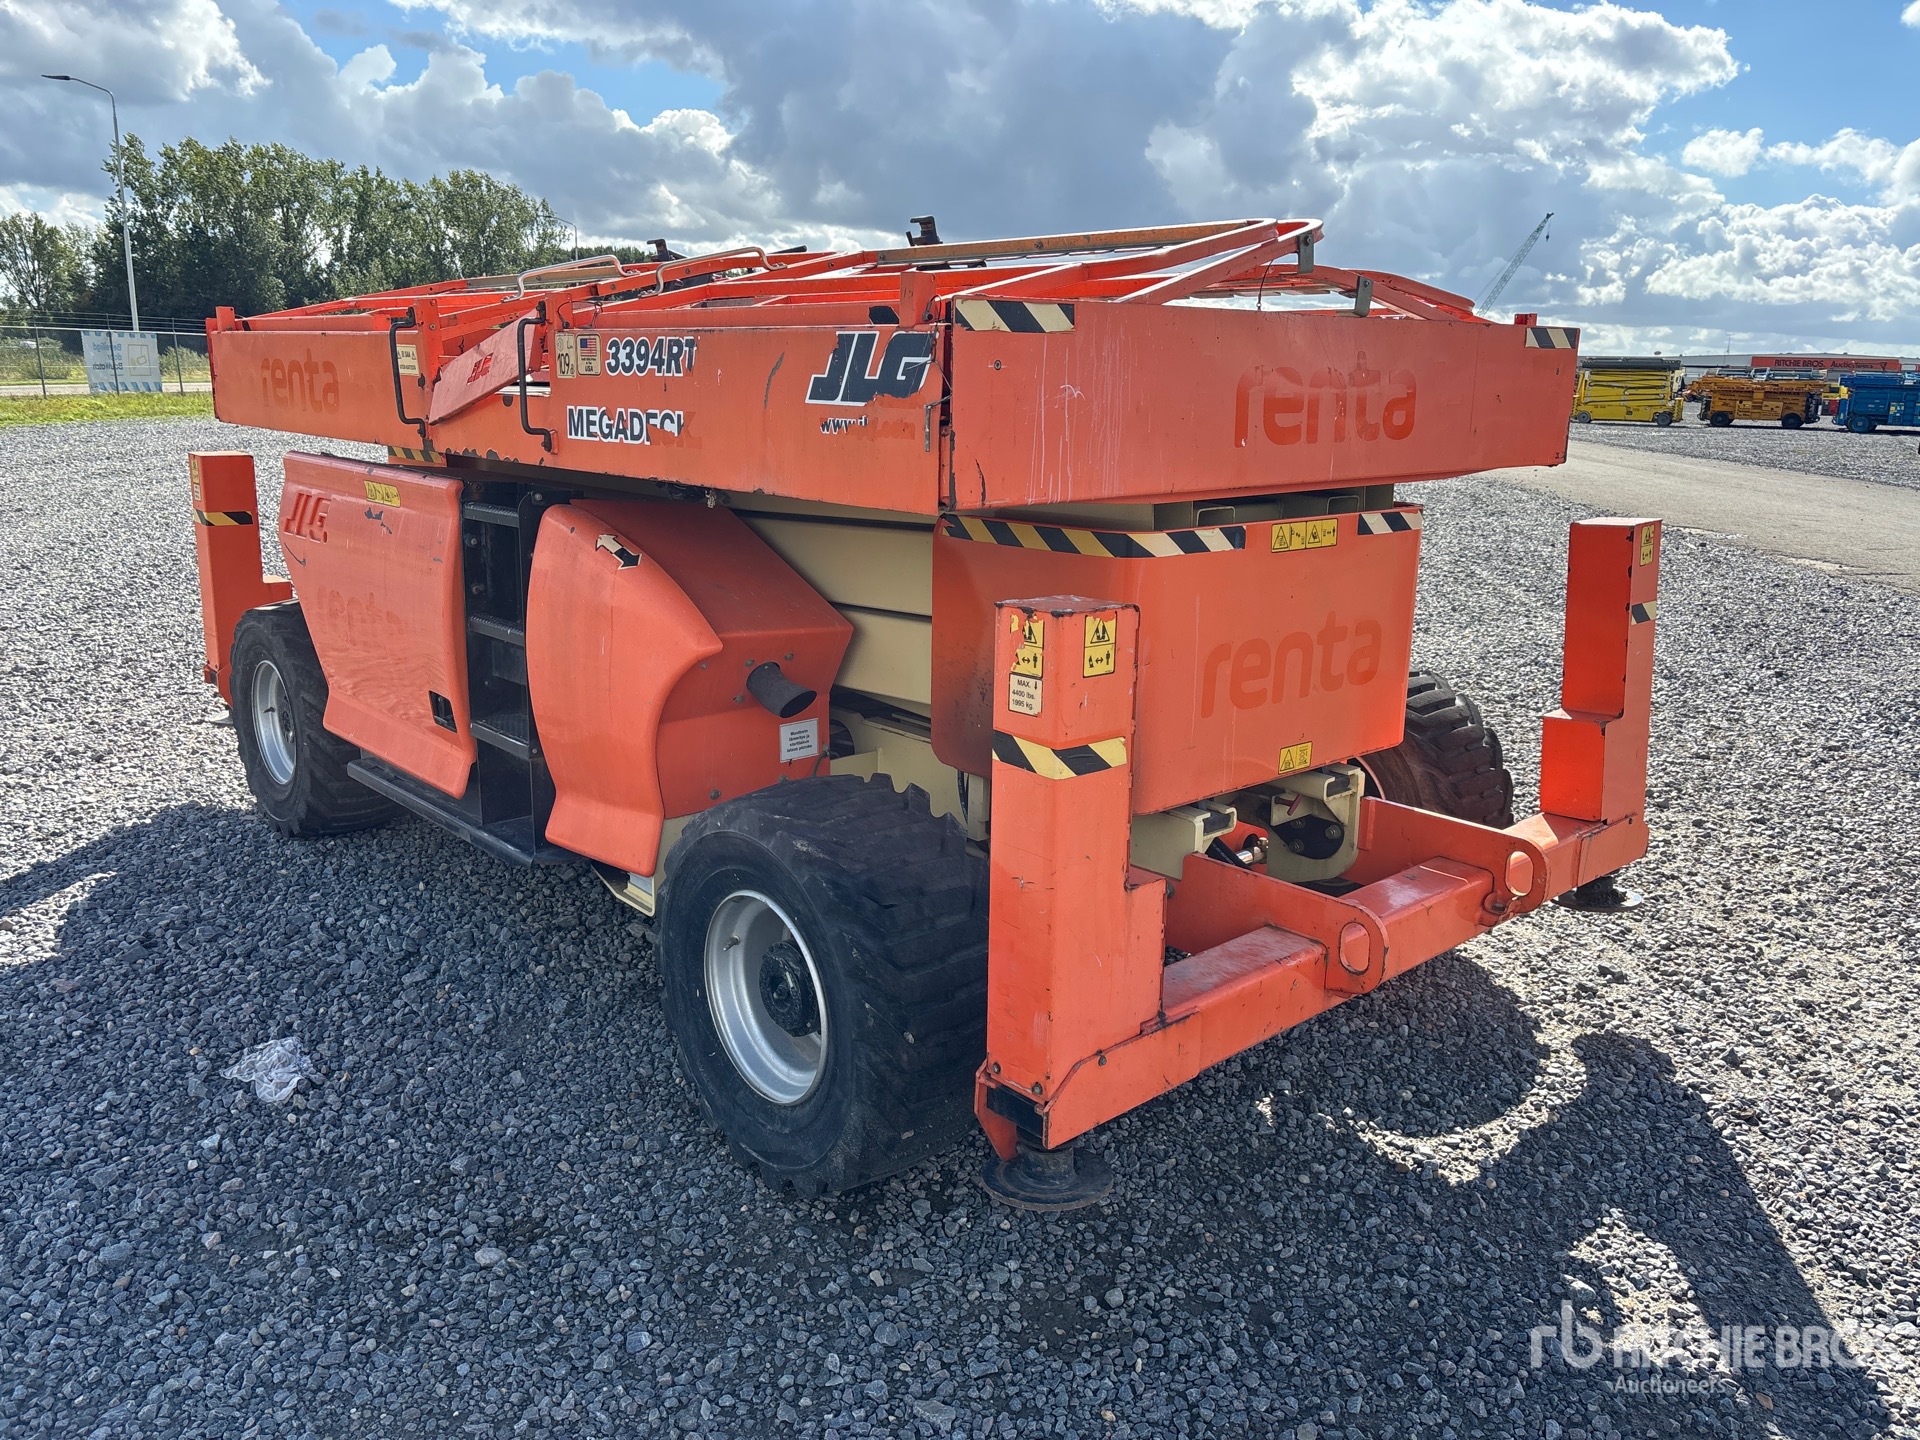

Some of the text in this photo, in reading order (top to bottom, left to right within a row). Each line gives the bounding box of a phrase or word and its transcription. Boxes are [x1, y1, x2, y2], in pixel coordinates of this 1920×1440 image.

[605, 336, 697, 376] 3394RT
[805, 331, 938, 406] JLG
[1774, 359, 1801, 367] RITCHIE
[1802, 359, 1826, 368] BROS.
[261, 348, 340, 415] renta
[1234, 351, 1416, 448] renta
[284, 491, 331, 543] JLG
[1017, 679, 1031, 688] MAX.
[1200, 610, 1382, 719] renta
[1012, 689, 1025, 697] 4400
[1012, 699, 1024, 707] 1995
